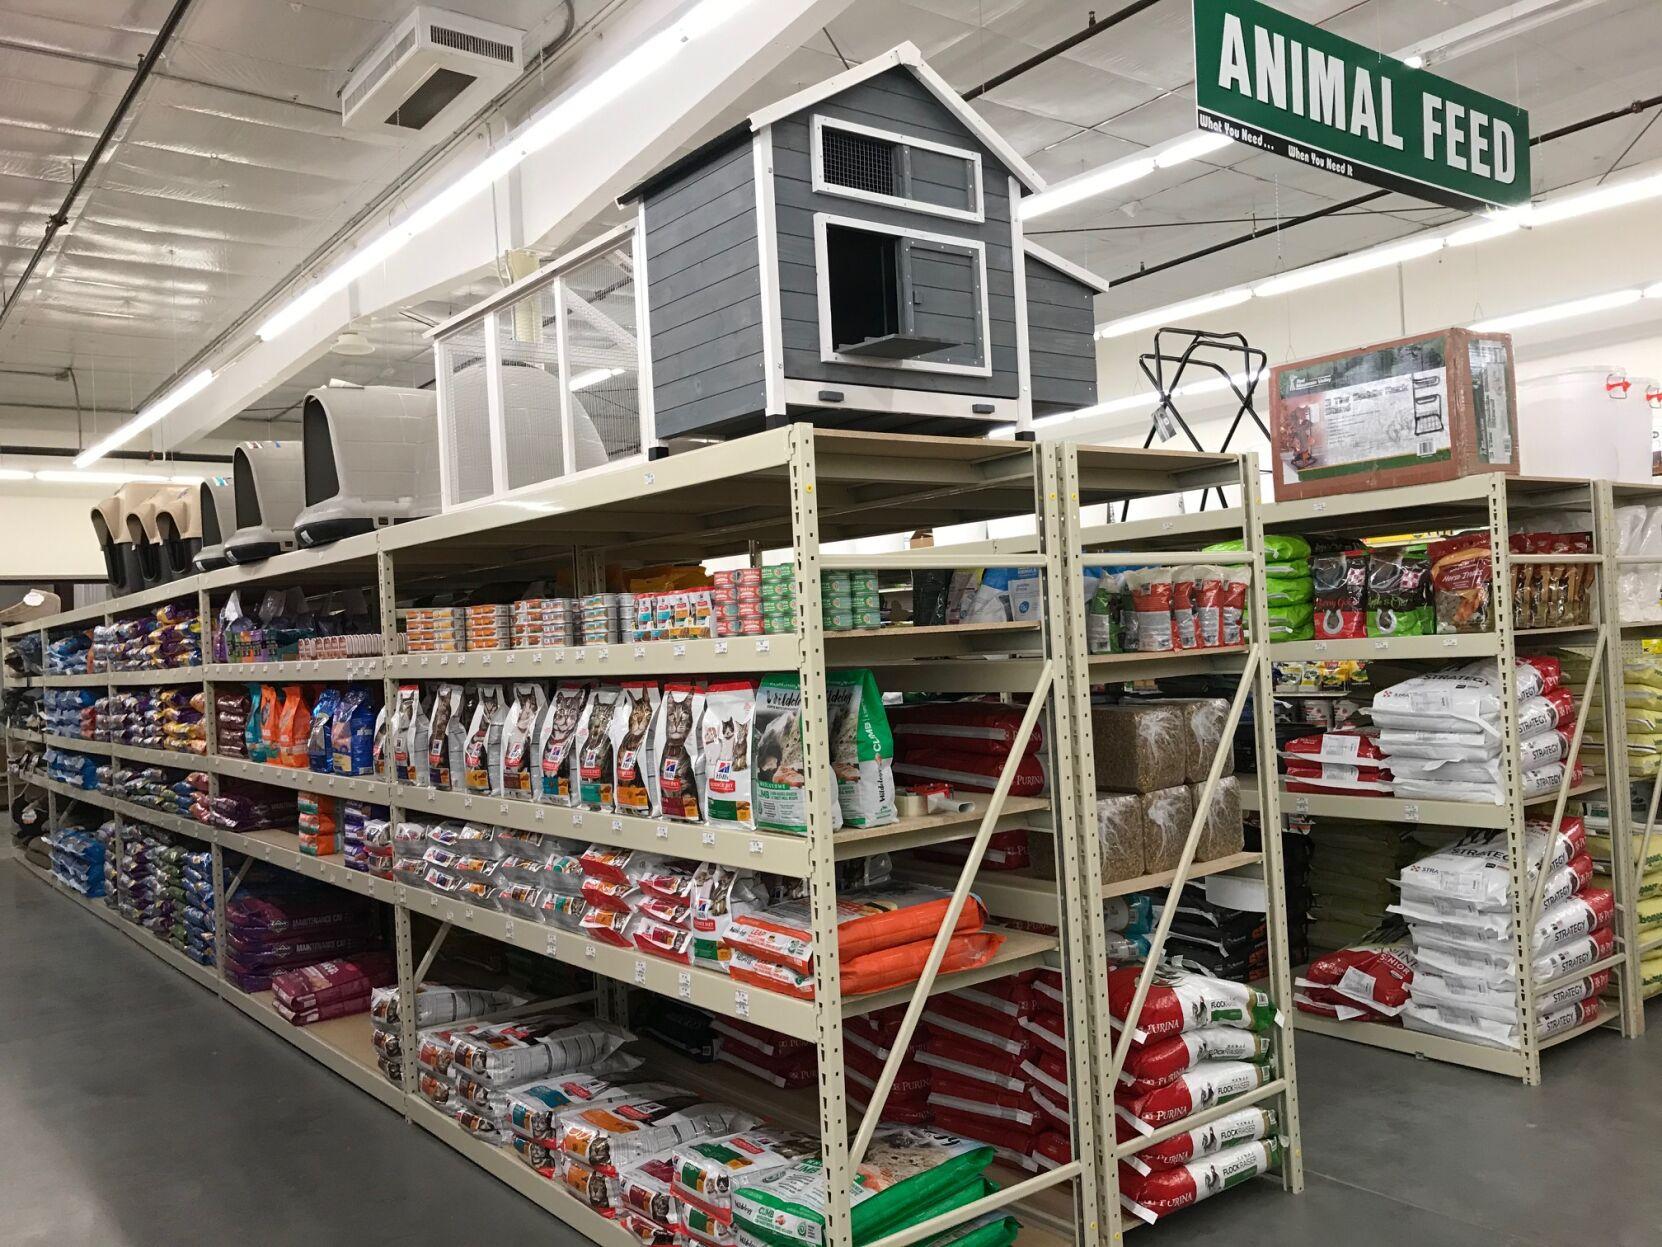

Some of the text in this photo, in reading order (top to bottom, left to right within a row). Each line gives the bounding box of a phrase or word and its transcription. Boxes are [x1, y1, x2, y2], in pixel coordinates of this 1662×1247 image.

[1218, 12, 1516, 185] ANIMAL FEED
[1200, 113, 1222, 133] What
[1224, 122, 1240, 138] You
[1288, 144, 1354, 176] When You Need It
[1518, 714, 1548, 734] STRATEGY
[1532, 743, 1559, 760] STRATEGY
[1016, 775, 1044, 786] PURINA
[1535, 773, 1561, 789] STRATEGY
[1543, 883, 1570, 911] STRATEGY
[1554, 921, 1586, 942] STRATEGY
[1561, 951, 1590, 972] STRATEGY
[1553, 984, 1583, 1003] STRATEGY
[1546, 1012, 1574, 1032] STRATEGY
[1157, 1106, 1188, 1121] PURINA
[1160, 1192, 1194, 1207] PURINA
